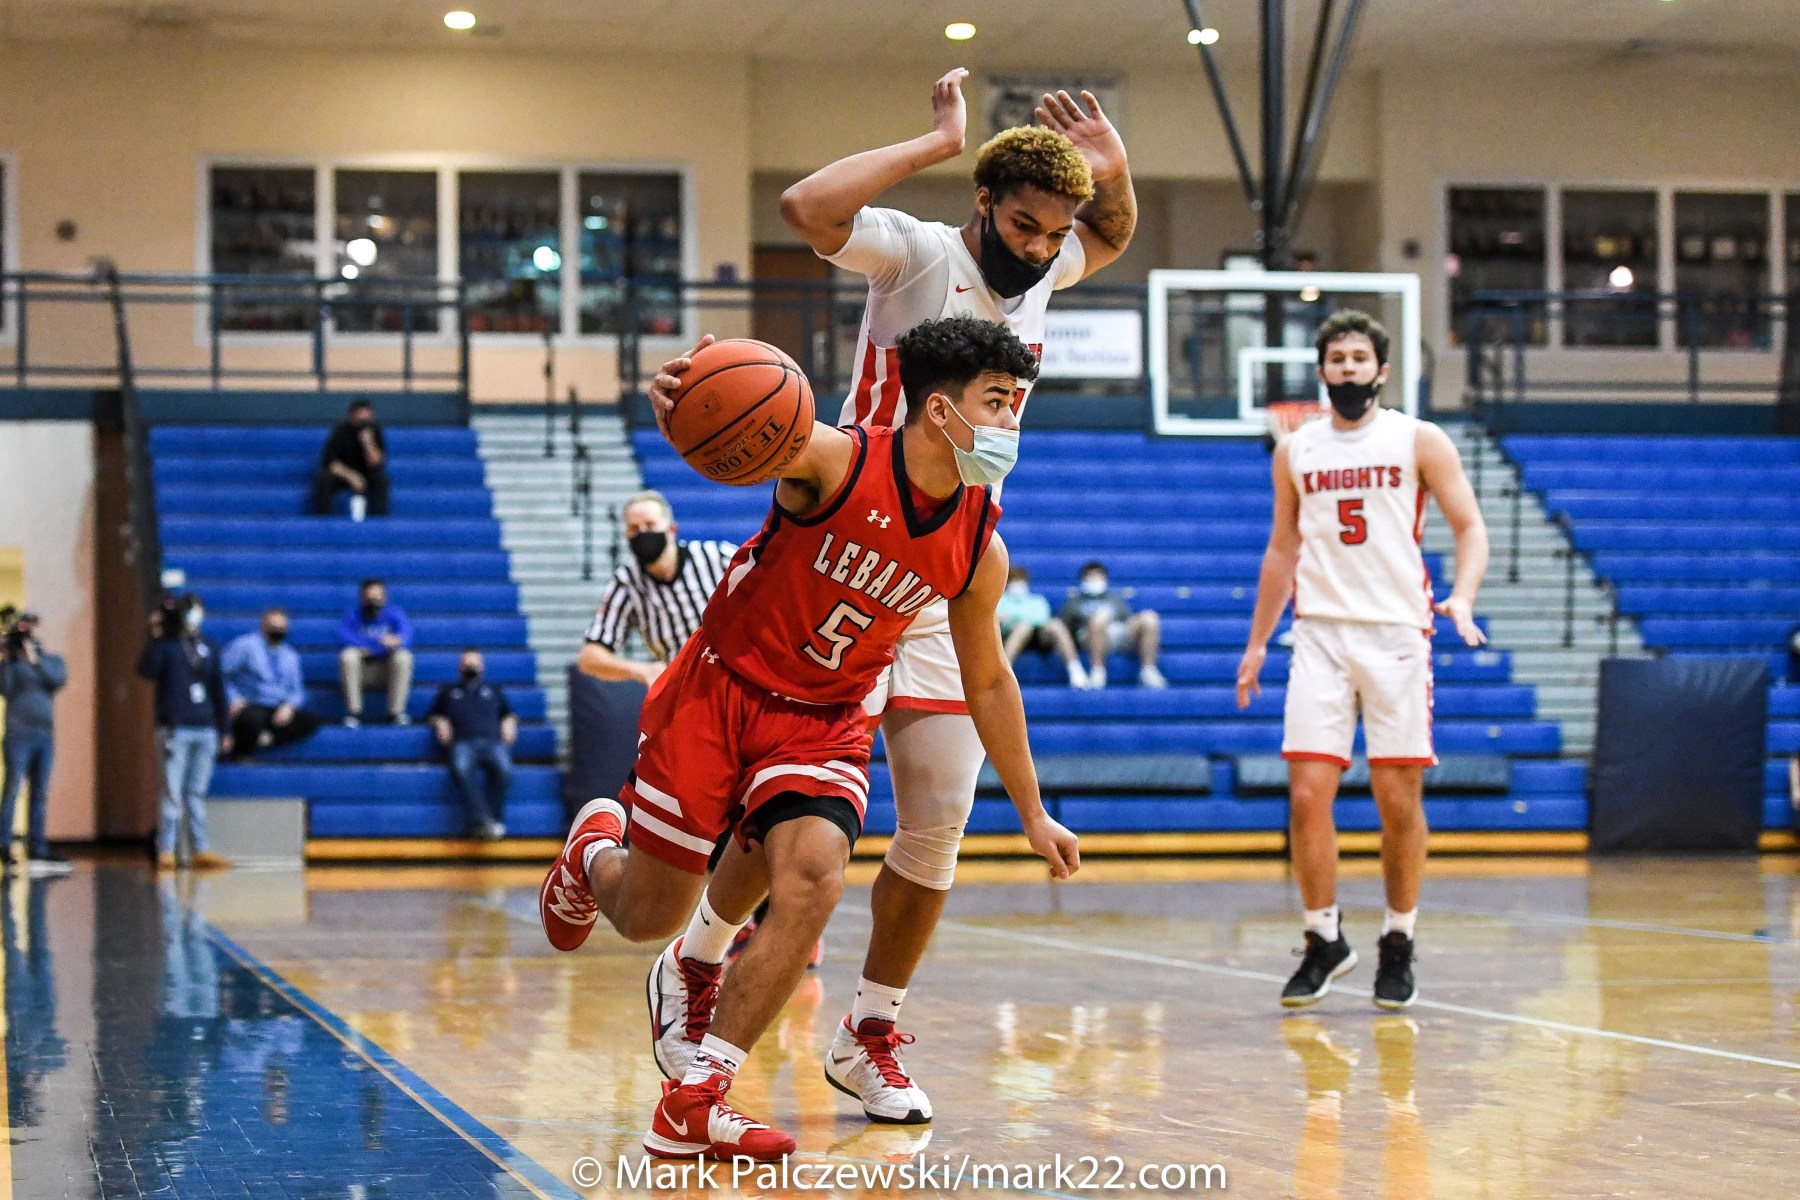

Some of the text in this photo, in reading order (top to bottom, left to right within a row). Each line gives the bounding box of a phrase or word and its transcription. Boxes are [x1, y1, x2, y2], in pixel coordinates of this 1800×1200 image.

[1303, 466, 1402, 494] KNIGHTS
[1337, 498, 1367, 545] 5
[801, 599, 876, 672] 5
